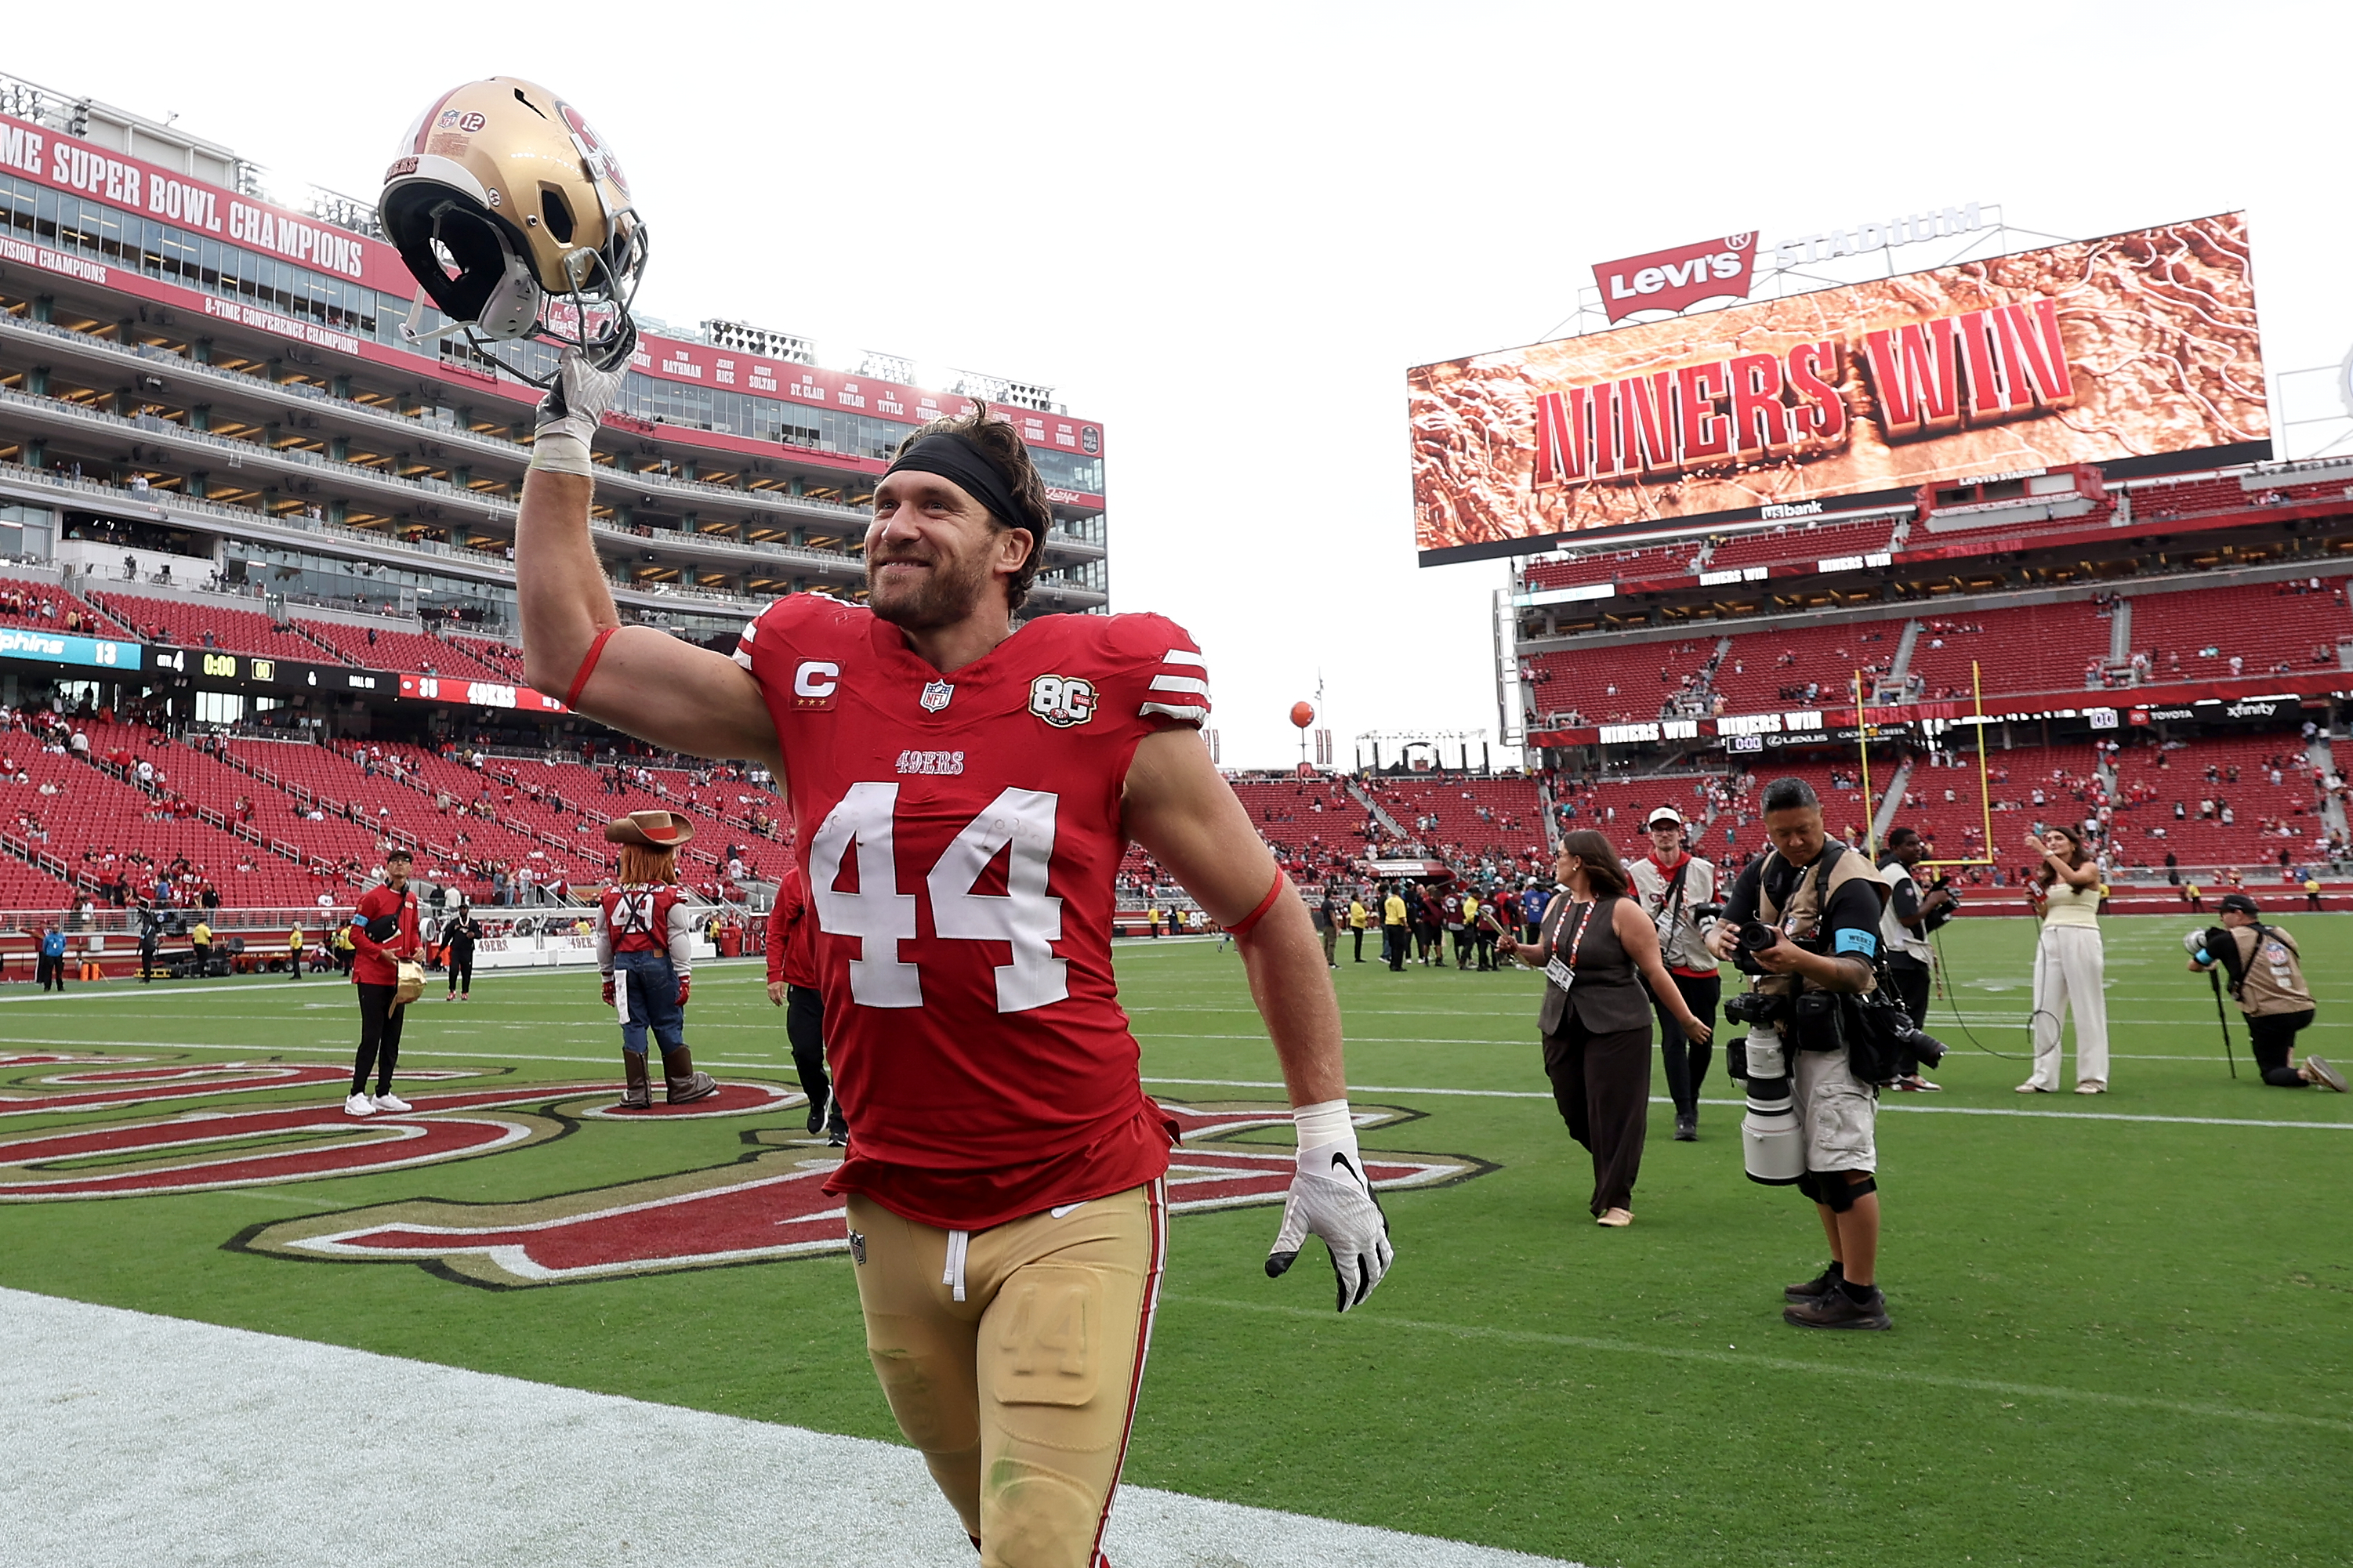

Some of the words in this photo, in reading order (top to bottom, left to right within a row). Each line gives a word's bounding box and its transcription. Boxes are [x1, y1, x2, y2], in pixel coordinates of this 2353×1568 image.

[461, 114, 484, 131] 12
[53, 141, 140, 207] SUPER
[148, 173, 221, 233] BOWL
[229, 201, 362, 277] CHAMPIONS
[1775, 201, 1983, 270] STADIUM
[39, 249, 107, 284] CHAMPIONS
[205, 297, 241, 320] 8-TIME
[242, 308, 305, 339] CONFERENCE
[306, 323, 360, 354] CHAMPIONS
[676, 350, 690, 361] TOM
[716, 358, 734, 370] JERRY
[662, 359, 702, 378] RATHMAN
[716, 369, 734, 384] RICE
[749, 375, 778, 392] SOLTAU
[802, 375, 814, 385] BOB
[790, 383, 802, 397] ST.
[803, 386, 825, 400] CLAIR
[838, 392, 865, 407] TAYLOR
[1535, 339, 1846, 491] NINERS
[1862, 296, 2076, 434] WIN
[877, 400, 904, 415] TITTLE
[1818, 556, 1864, 573] NINERS
[1865, 552, 1891, 568] WIN
[1699, 570, 1742, 586] NINERS
[1743, 567, 1768, 581] WIN
[95, 642, 117, 665] 13
[172, 650, 184, 672] 4
[204, 654, 235, 677] 0:00
[255, 662, 270, 679] 00
[348, 675, 363, 688] BALL
[364, 676, 375, 689] ON
[794, 661, 839, 697] C
[419, 678, 438, 698] 35
[467, 682, 517, 709] 49ERS
[926, 693, 944, 706] NFL
[2094, 713, 2114, 726] 00
[2150, 709, 2194, 721] TOYOTA
[2226, 702, 2276, 719] xfinity
[1599, 722, 1659, 744] NINERS
[1662, 720, 1698, 740] WIN
[1717, 714, 1782, 736] NINERS
[1785, 711, 1822, 731] WIN
[1782, 733, 1829, 744] LEXUS
[895, 749, 965, 775] 49ERS
[810, 782, 1069, 1013] 44
[479, 940, 509, 952] 49ERS
